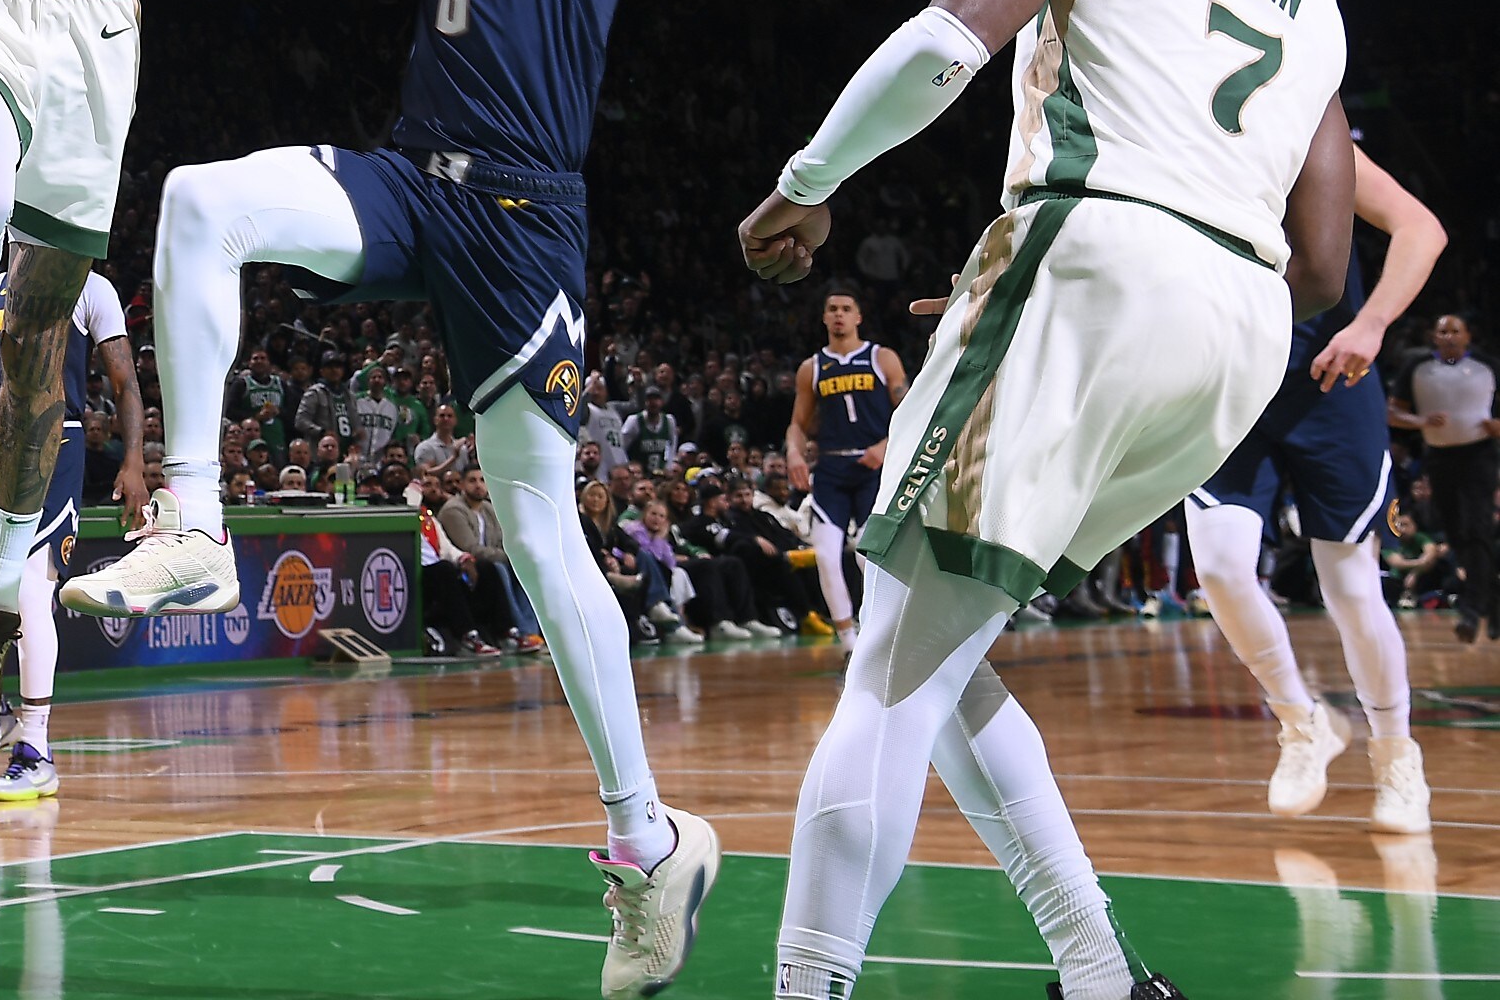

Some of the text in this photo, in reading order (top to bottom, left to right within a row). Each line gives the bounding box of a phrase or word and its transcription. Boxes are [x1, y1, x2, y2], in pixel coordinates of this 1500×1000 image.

[1205, 0, 1285, 138] 7
[818, 373, 875, 397] DENVER
[843, 393, 858, 423] 1
[338, 416, 351, 437] 6
[897, 425, 947, 511] CELTICS
[265, 574, 329, 615] LAKERS
[225, 616, 249, 632] TNT
